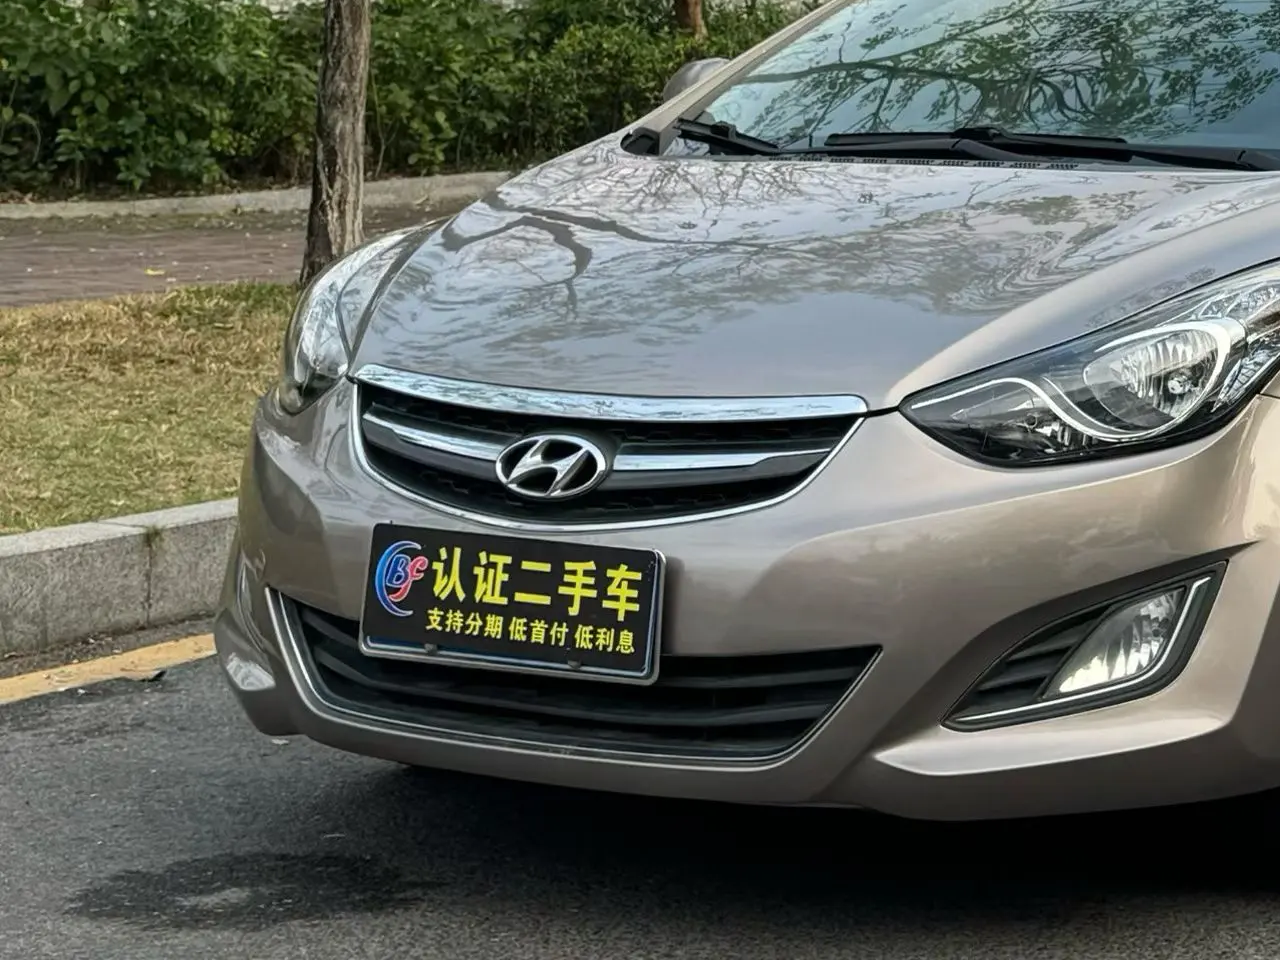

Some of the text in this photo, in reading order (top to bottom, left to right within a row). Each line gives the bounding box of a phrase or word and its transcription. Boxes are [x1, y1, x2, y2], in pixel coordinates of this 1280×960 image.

[432, 547, 643, 622] 认证二手车
[426, 608, 635, 654] 支持分期 低首付 低利息
